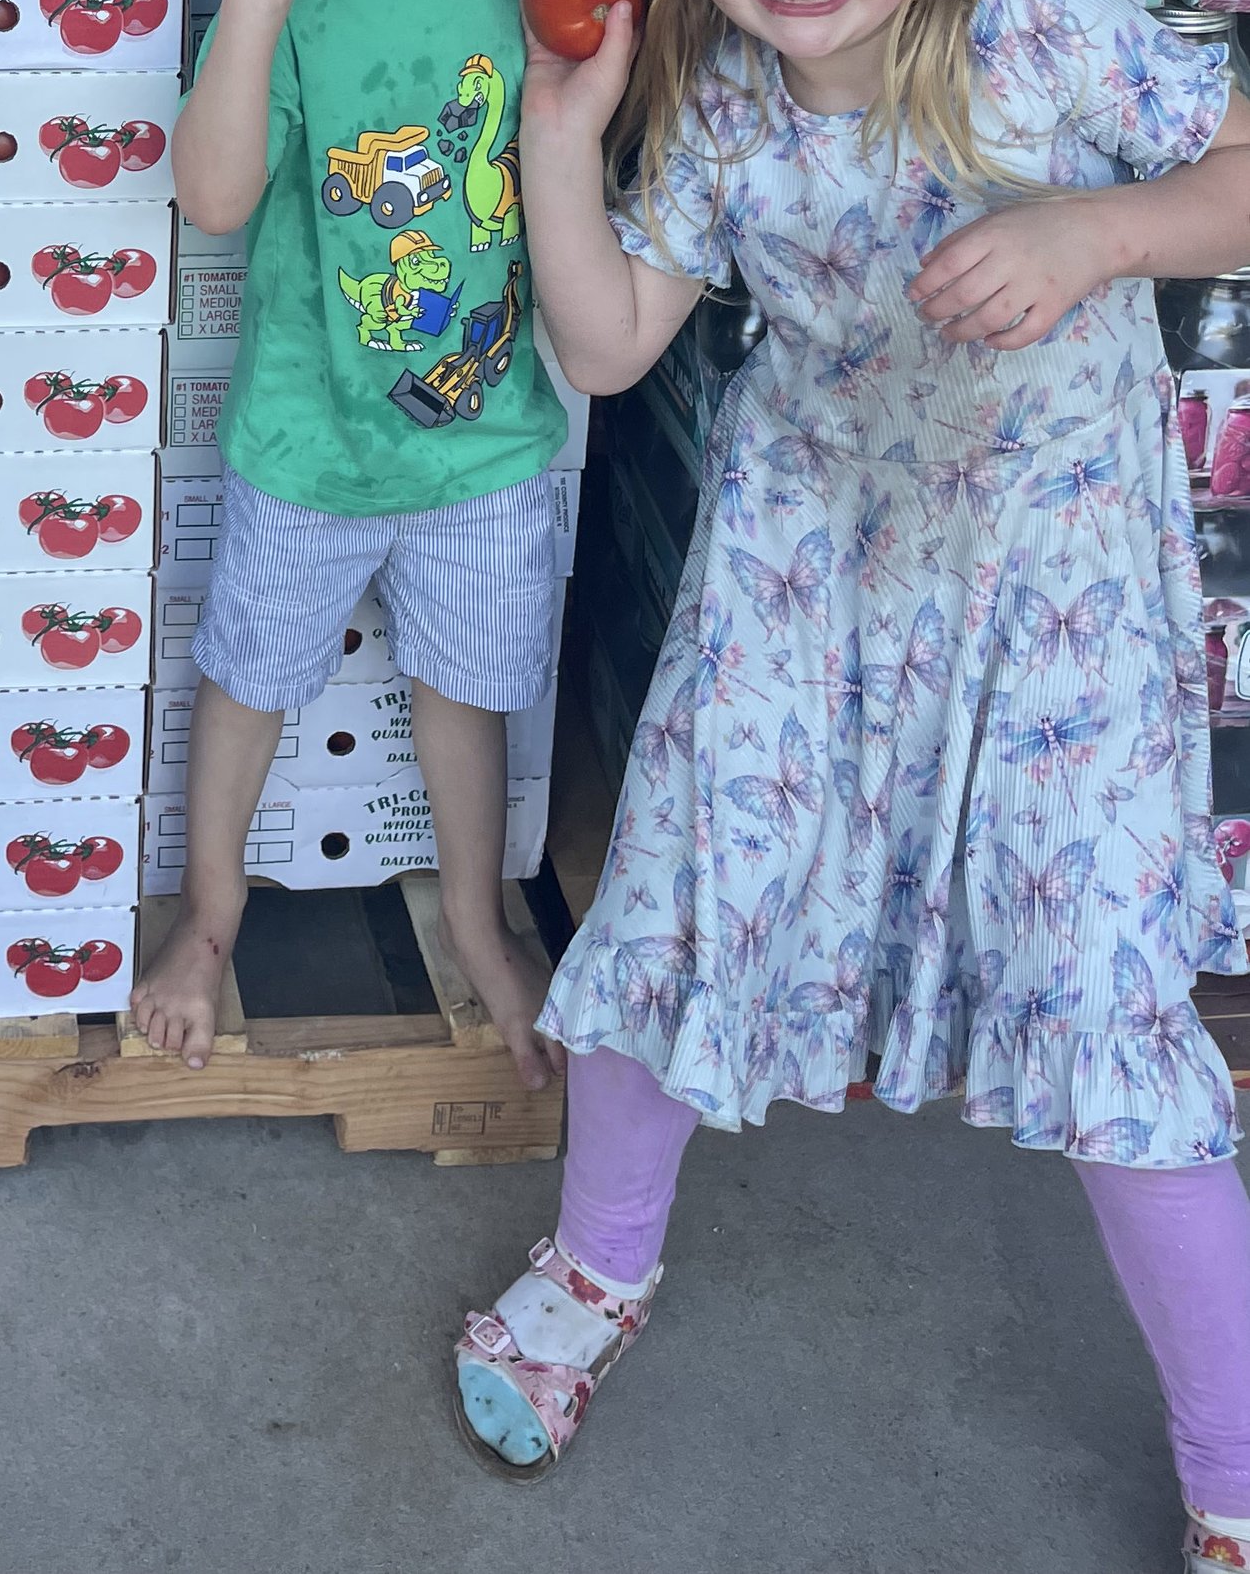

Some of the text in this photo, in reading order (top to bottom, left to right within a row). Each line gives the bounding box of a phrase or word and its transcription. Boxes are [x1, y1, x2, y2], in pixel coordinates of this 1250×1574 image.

[200, 285, 238, 296] SMALL
[200, 310, 240, 321] LARGE
[365, 833, 424, 844] QUALITY
[380, 856, 435, 867] DALTON
